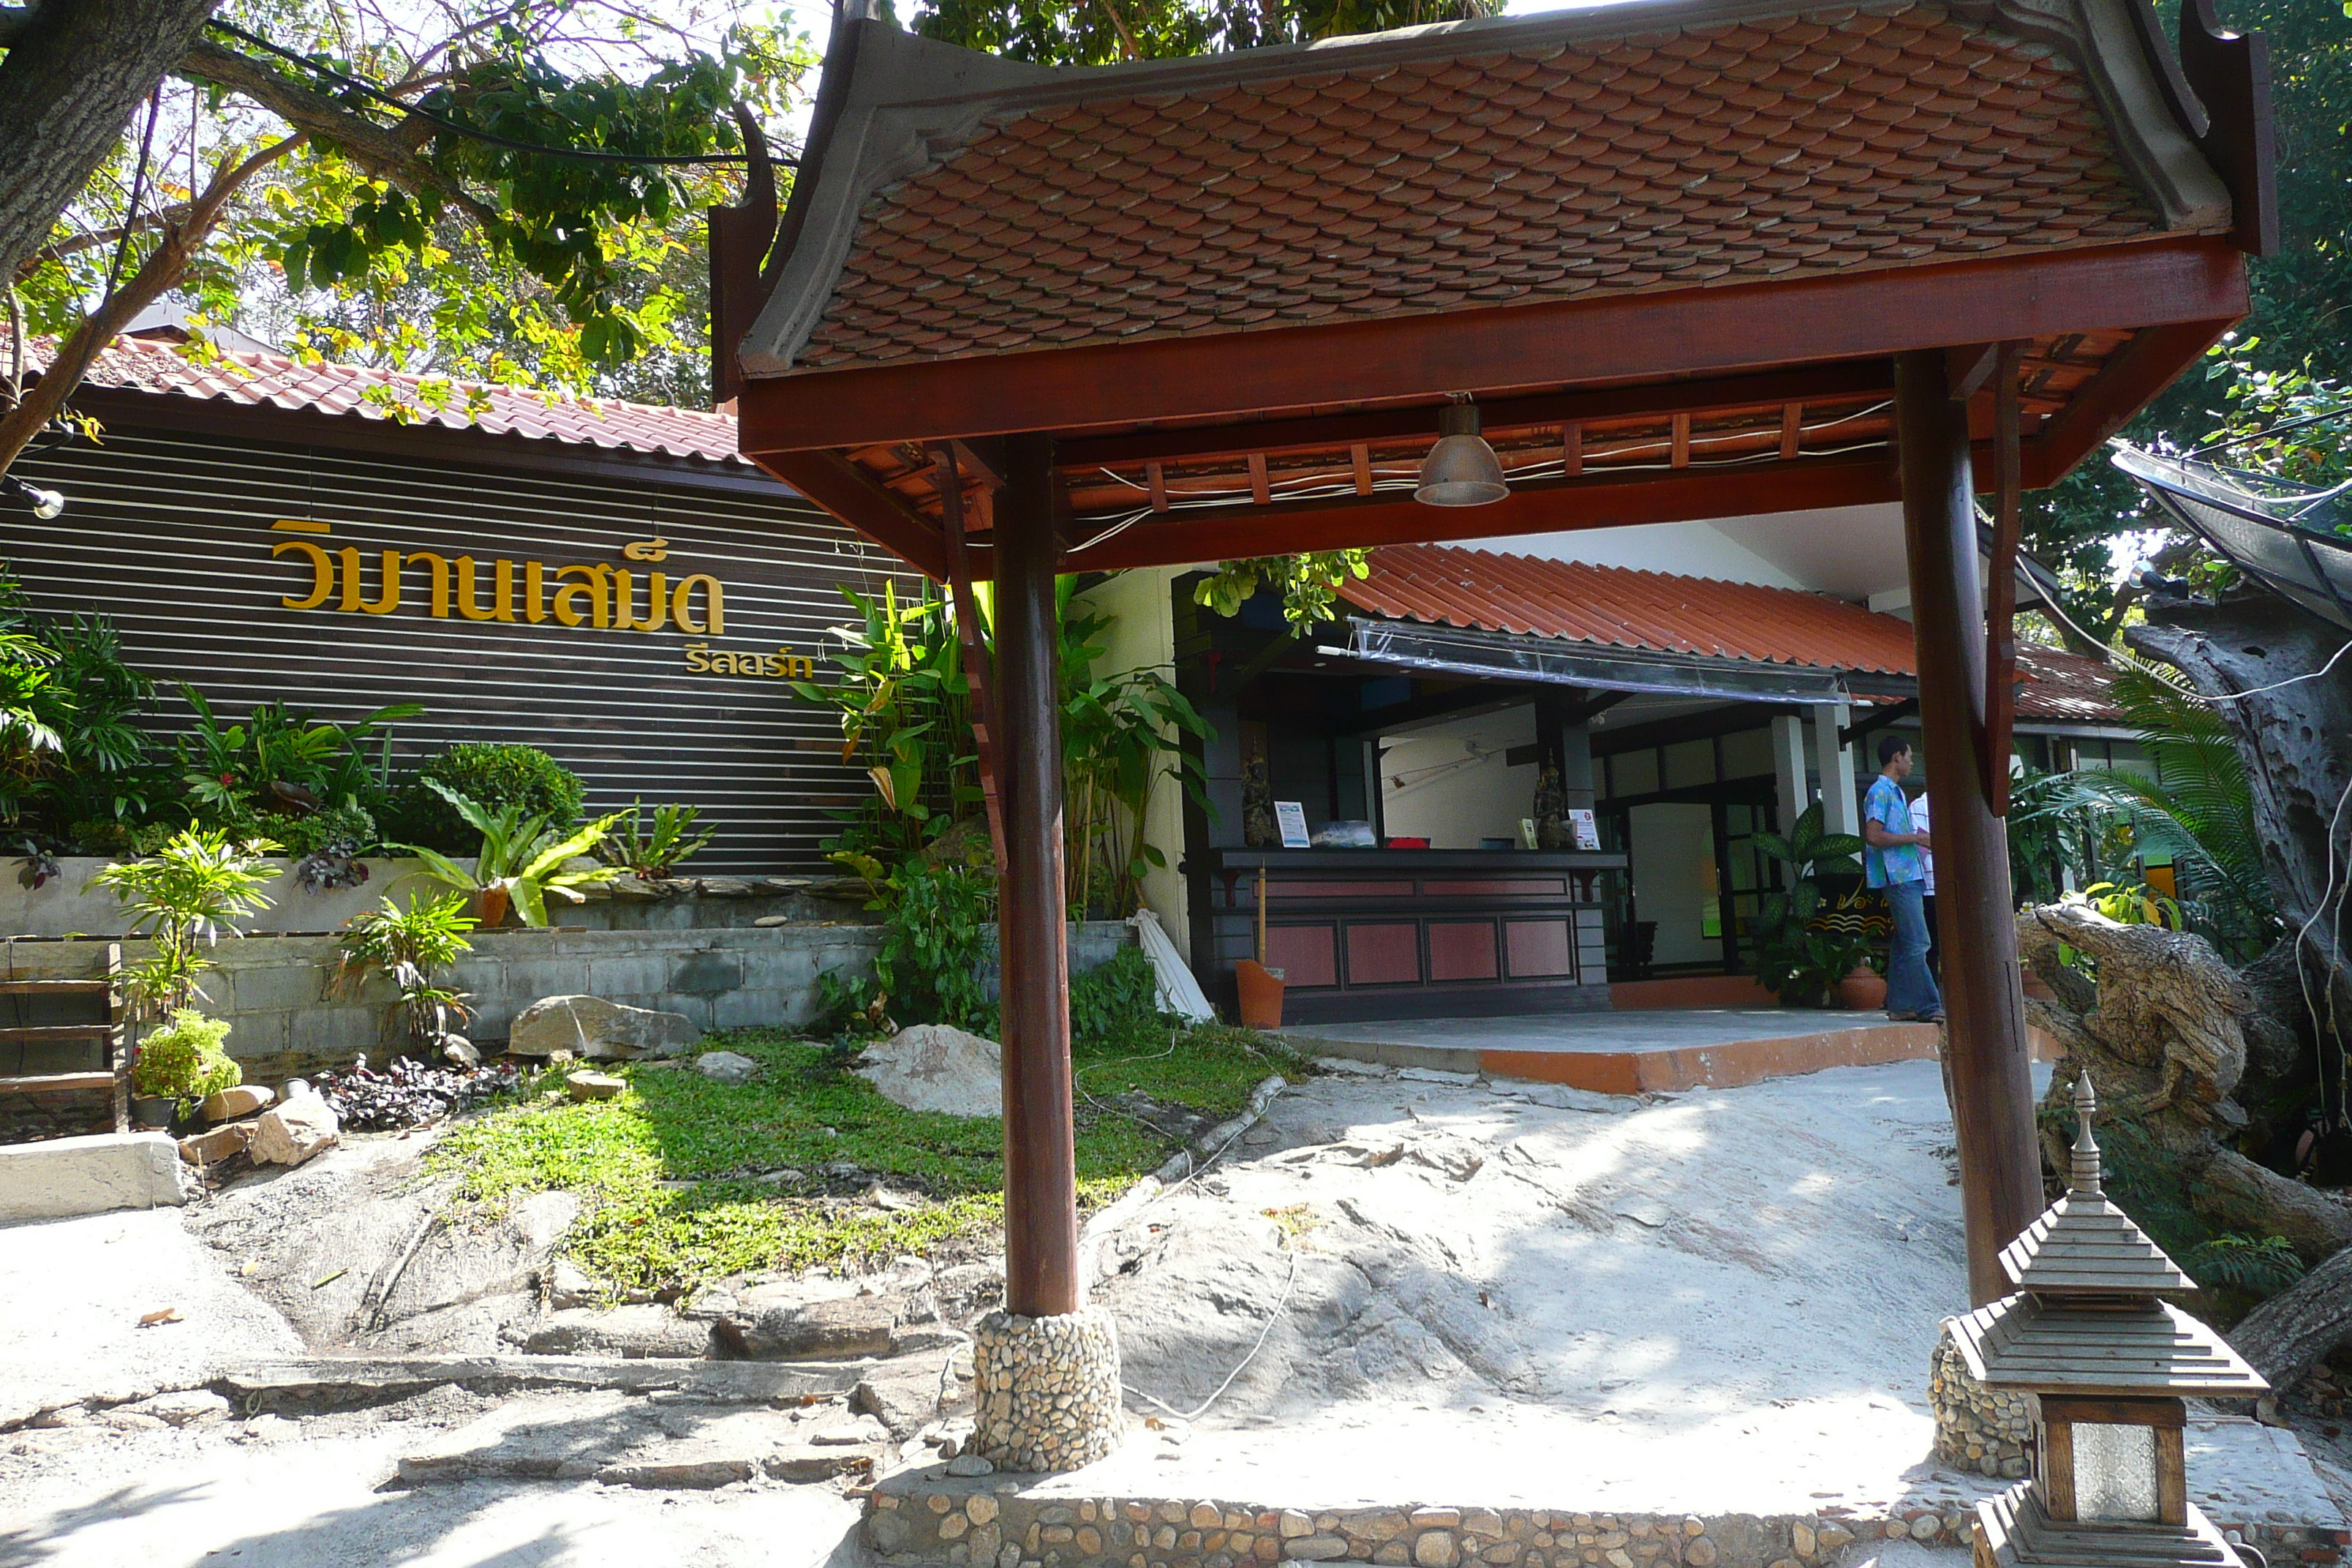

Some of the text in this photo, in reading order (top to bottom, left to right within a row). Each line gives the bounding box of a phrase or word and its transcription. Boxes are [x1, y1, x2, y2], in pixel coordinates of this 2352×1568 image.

[271, 520, 725, 635] วิมานเสม็ด
[684, 643, 813, 679] รีสอร์ท
